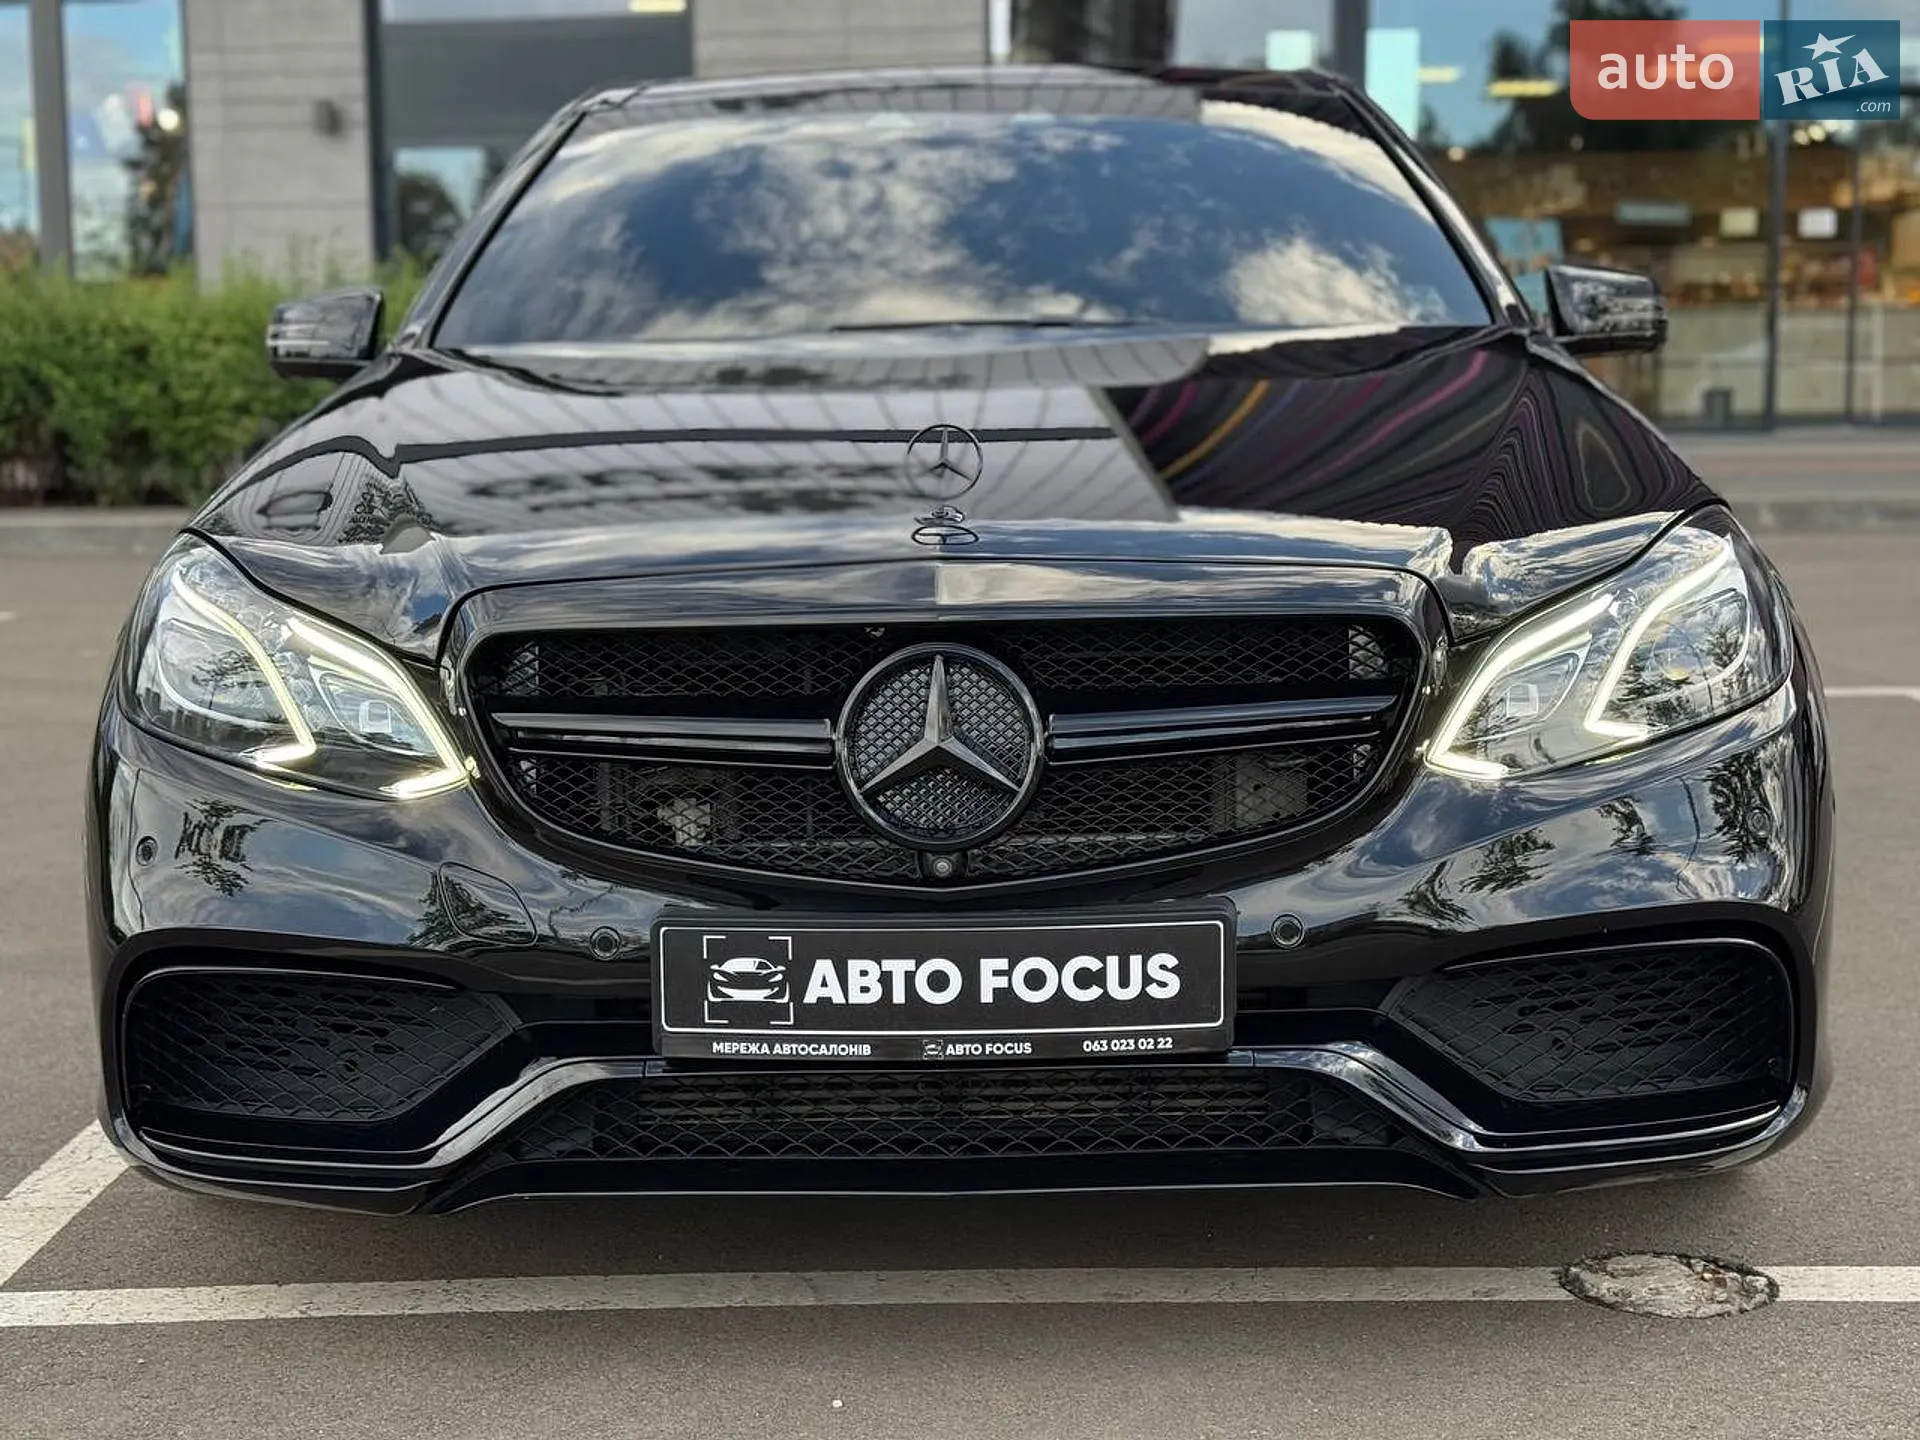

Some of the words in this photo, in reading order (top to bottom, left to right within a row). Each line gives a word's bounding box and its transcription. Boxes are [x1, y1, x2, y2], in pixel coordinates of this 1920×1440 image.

[803, 957, 963, 1005] АВТО
[980, 952, 1181, 1004] FOCUS
[712, 1041, 770, 1055] МЕРЕЖА
[773, 1042, 872, 1057] АВТОСАЛОНІВ
[945, 1043, 982, 1056] АВТО
[985, 1042, 1032, 1056] FOCUS
[1083, 1039, 1109, 1053] 063
[1111, 1038, 1136, 1052] 023
[1138, 1038, 1156, 1052] 02
[1157, 1037, 1173, 1051] 22
